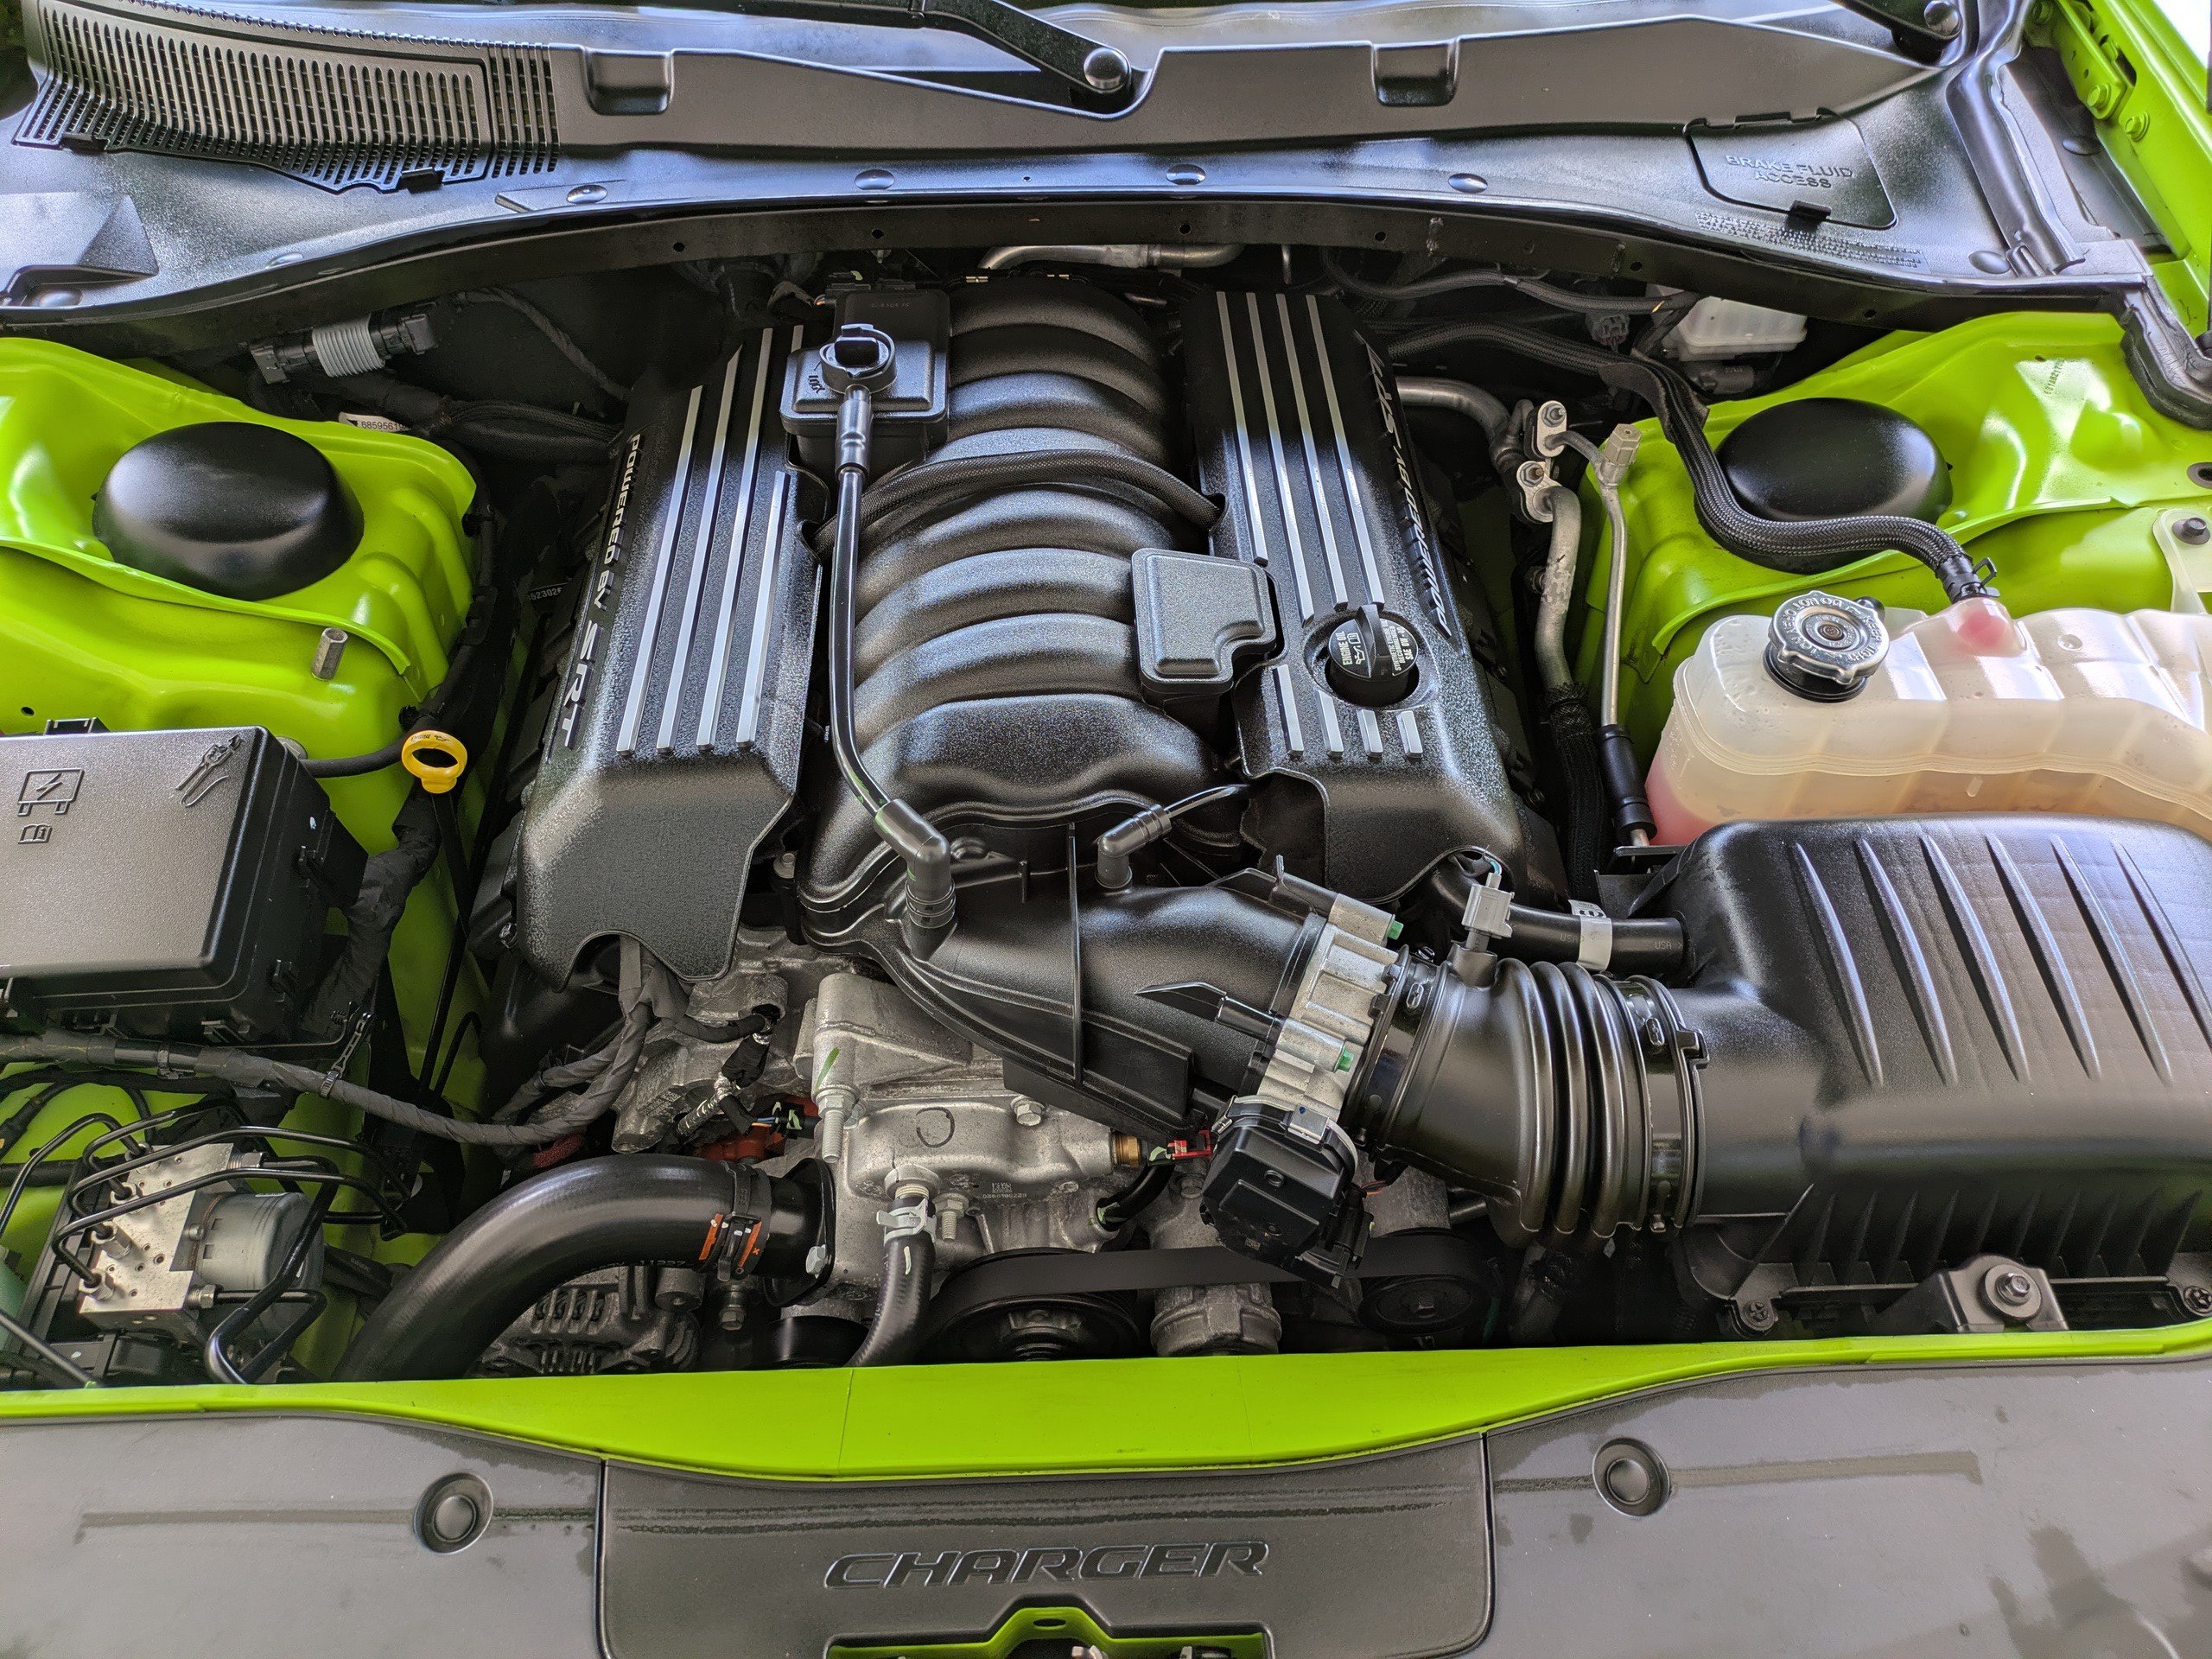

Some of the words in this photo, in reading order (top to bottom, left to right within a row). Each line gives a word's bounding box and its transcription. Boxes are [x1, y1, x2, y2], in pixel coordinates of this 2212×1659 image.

[1726, 155, 1793, 173] BRAKE
[1796, 164, 1853, 177] FLUID
[1755, 171, 1832, 188] ACCESS
[1393, 445, 1413, 490] BY
[604, 434, 641, 565] POWERED
[1405, 486, 1452, 638] POWERED
[594, 569, 613, 611] BY
[1335, 631, 1346, 640] OIL
[1389, 626, 1406, 664] RECOMMENDED
[1338, 641, 1352, 665] ENGINE
[1387, 644, 1402, 671] SYNTHETIC
[1402, 648, 1414, 659] SAE
[562, 620, 599, 747] SRT
[1560, 934, 1579, 944] USA
[1654, 941, 1672, 950] USA
[823, 1541, 1270, 1589] CHARGER
